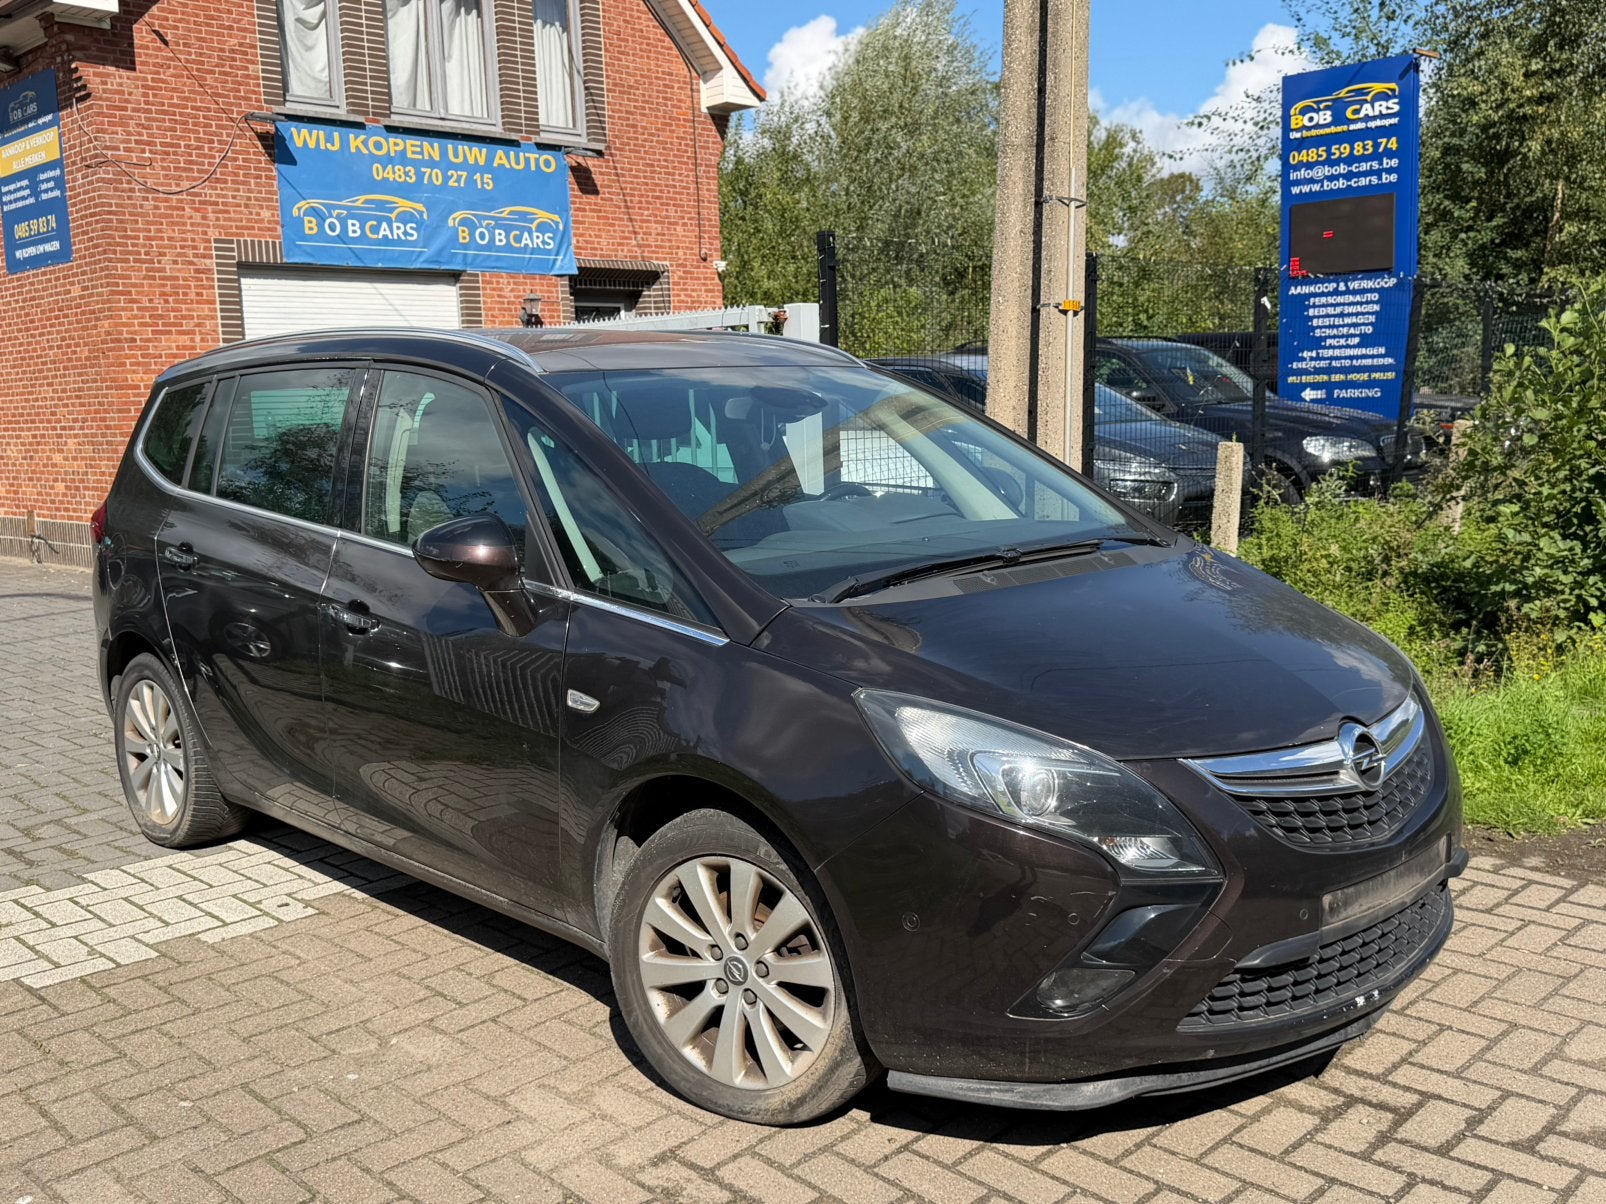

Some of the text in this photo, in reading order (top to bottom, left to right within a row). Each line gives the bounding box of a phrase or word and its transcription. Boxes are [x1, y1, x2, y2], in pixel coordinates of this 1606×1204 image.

[1290, 99, 1400, 129] BOB CARS
[1302, 124, 1348, 138] betrouwbare
[1349, 122, 1366, 131] auto
[1367, 117, 1399, 129] opkoper
[30, 131, 54, 147] VERKOOP
[25, 150, 46, 165] MERKEN
[291, 127, 557, 173] WIJ KOPEN UW AUTO
[1289, 137, 1398, 165] 0485 59 83 74
[372, 163, 494, 190] 0483 70 27 15
[1289, 157, 1399, 180] info@bob-cars.be
[1290, 173, 1398, 195] www.bob-cars.be
[14, 214, 57, 240] 0485 59 83 74
[45, 240, 60, 253] WAGEN
[1288, 278, 1397, 295] AANKOOP & VERKOOP
[1318, 346, 1385, 358] TERREINWAGEN
[1331, 359, 1351, 367] AUTO
[1330, 374, 1346, 382] EEN
[1347, 372, 1369, 381] HOGE
[1333, 387, 1382, 398] PARKING
